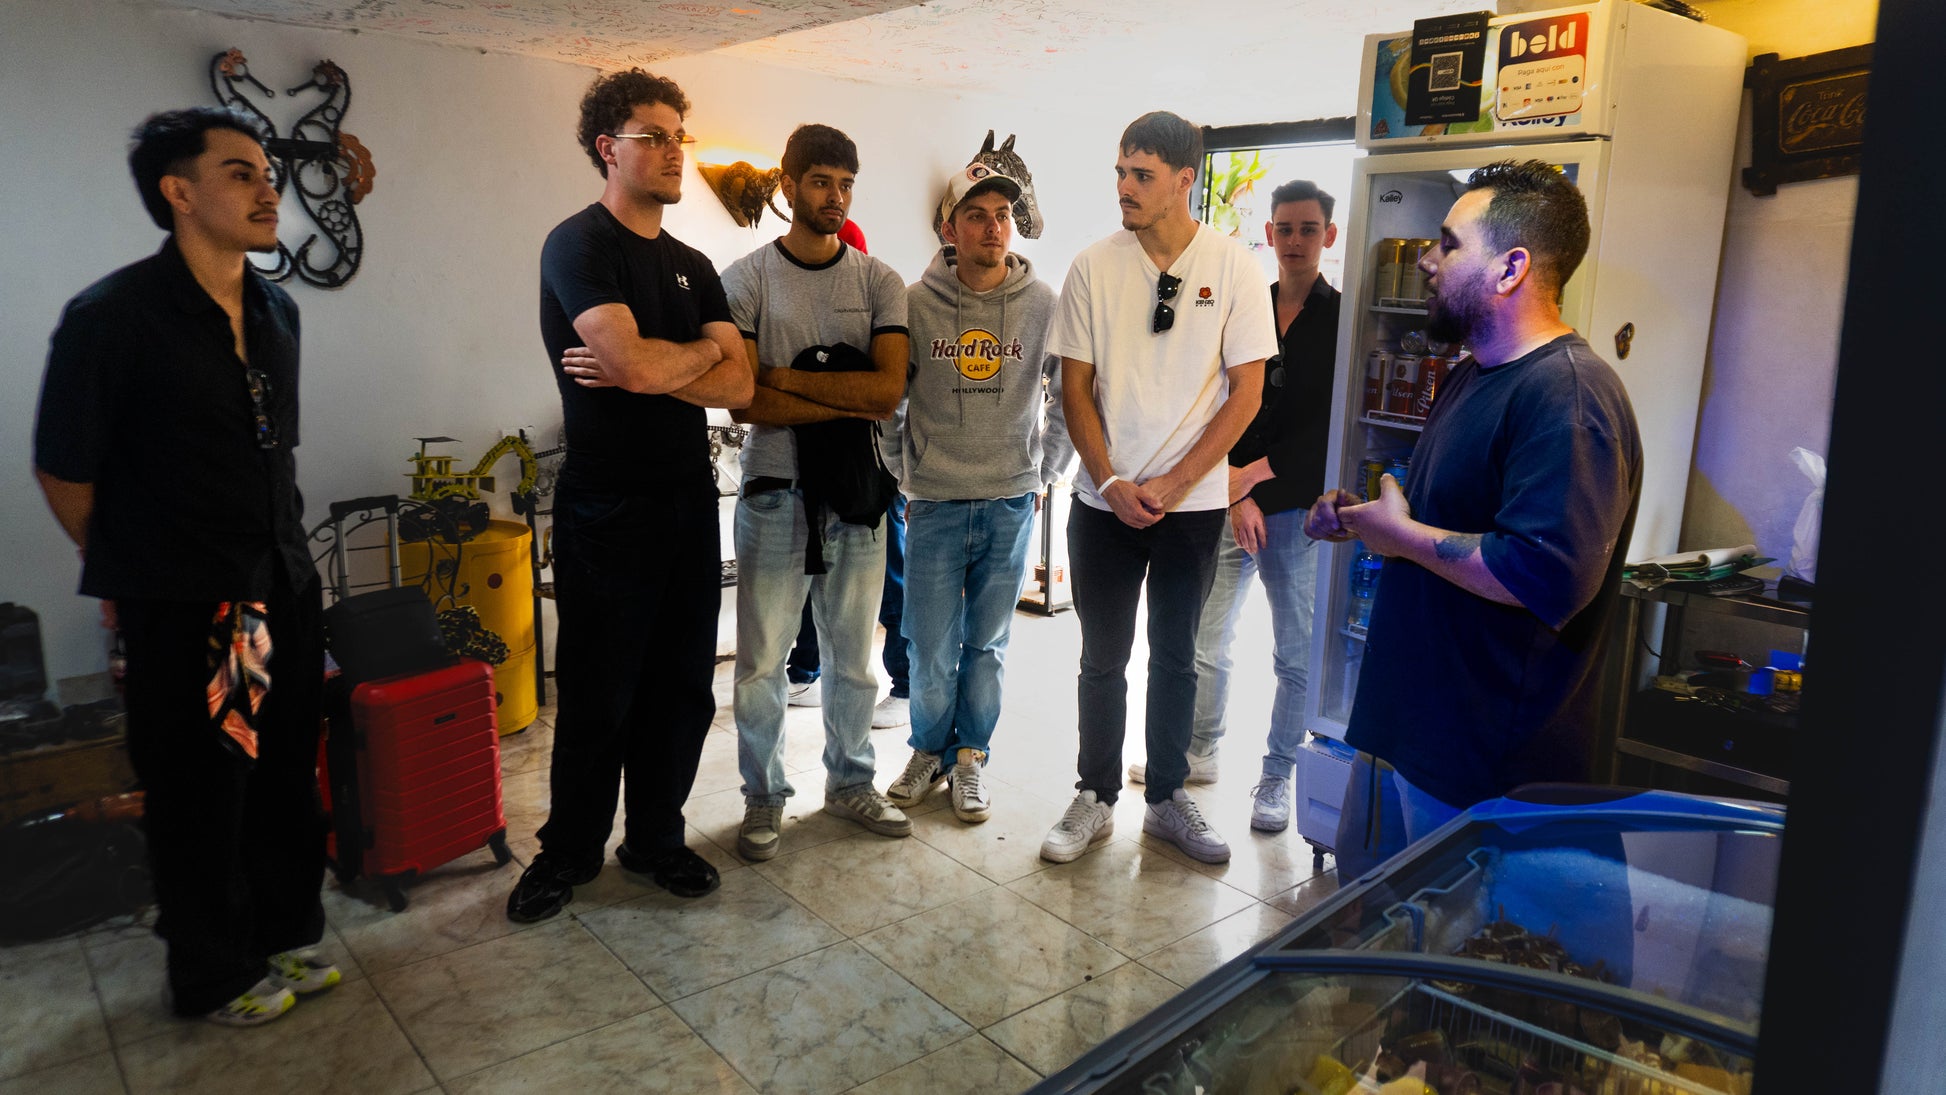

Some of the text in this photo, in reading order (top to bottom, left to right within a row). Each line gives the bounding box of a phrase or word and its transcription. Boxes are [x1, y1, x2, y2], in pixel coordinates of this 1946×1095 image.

[1510, 22, 1577, 58] bold
[1517, 68, 1535, 77] Paga
[1379, 193, 1403, 204] Kalley
[930, 337, 1024, 361] Hard Rock
[967, 363, 991, 372] CAFE
[1416, 370, 1436, 413] Pilsen
